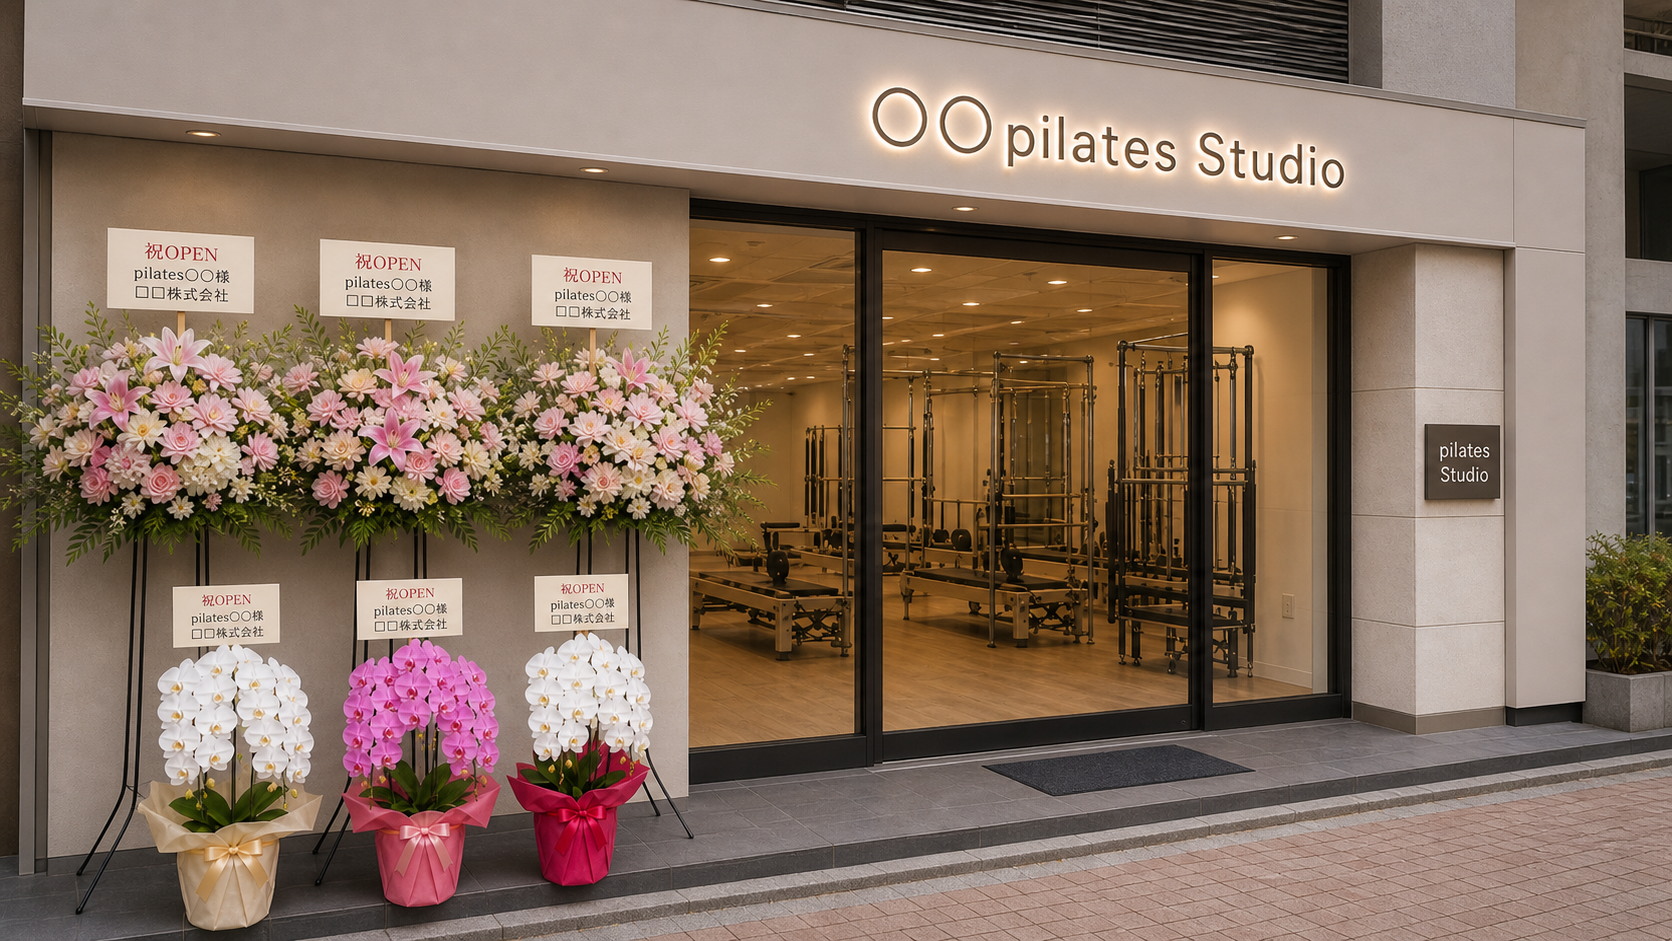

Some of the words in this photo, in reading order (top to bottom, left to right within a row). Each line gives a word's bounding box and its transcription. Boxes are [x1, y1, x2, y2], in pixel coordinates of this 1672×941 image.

[1198, 132, 1346, 189] Studio
[145, 242, 218, 262] 祝OPEN
[355, 252, 422, 271] 祝OPEN
[563, 266, 622, 284] 祝OPEN
[1439, 441, 1490, 462] pilates
[1440, 466, 1489, 483] Studio
[385, 587, 435, 600] 祝OPEN
[561, 582, 605, 595] 祝OPEN
[201, 594, 251, 607] 祝OPEN
